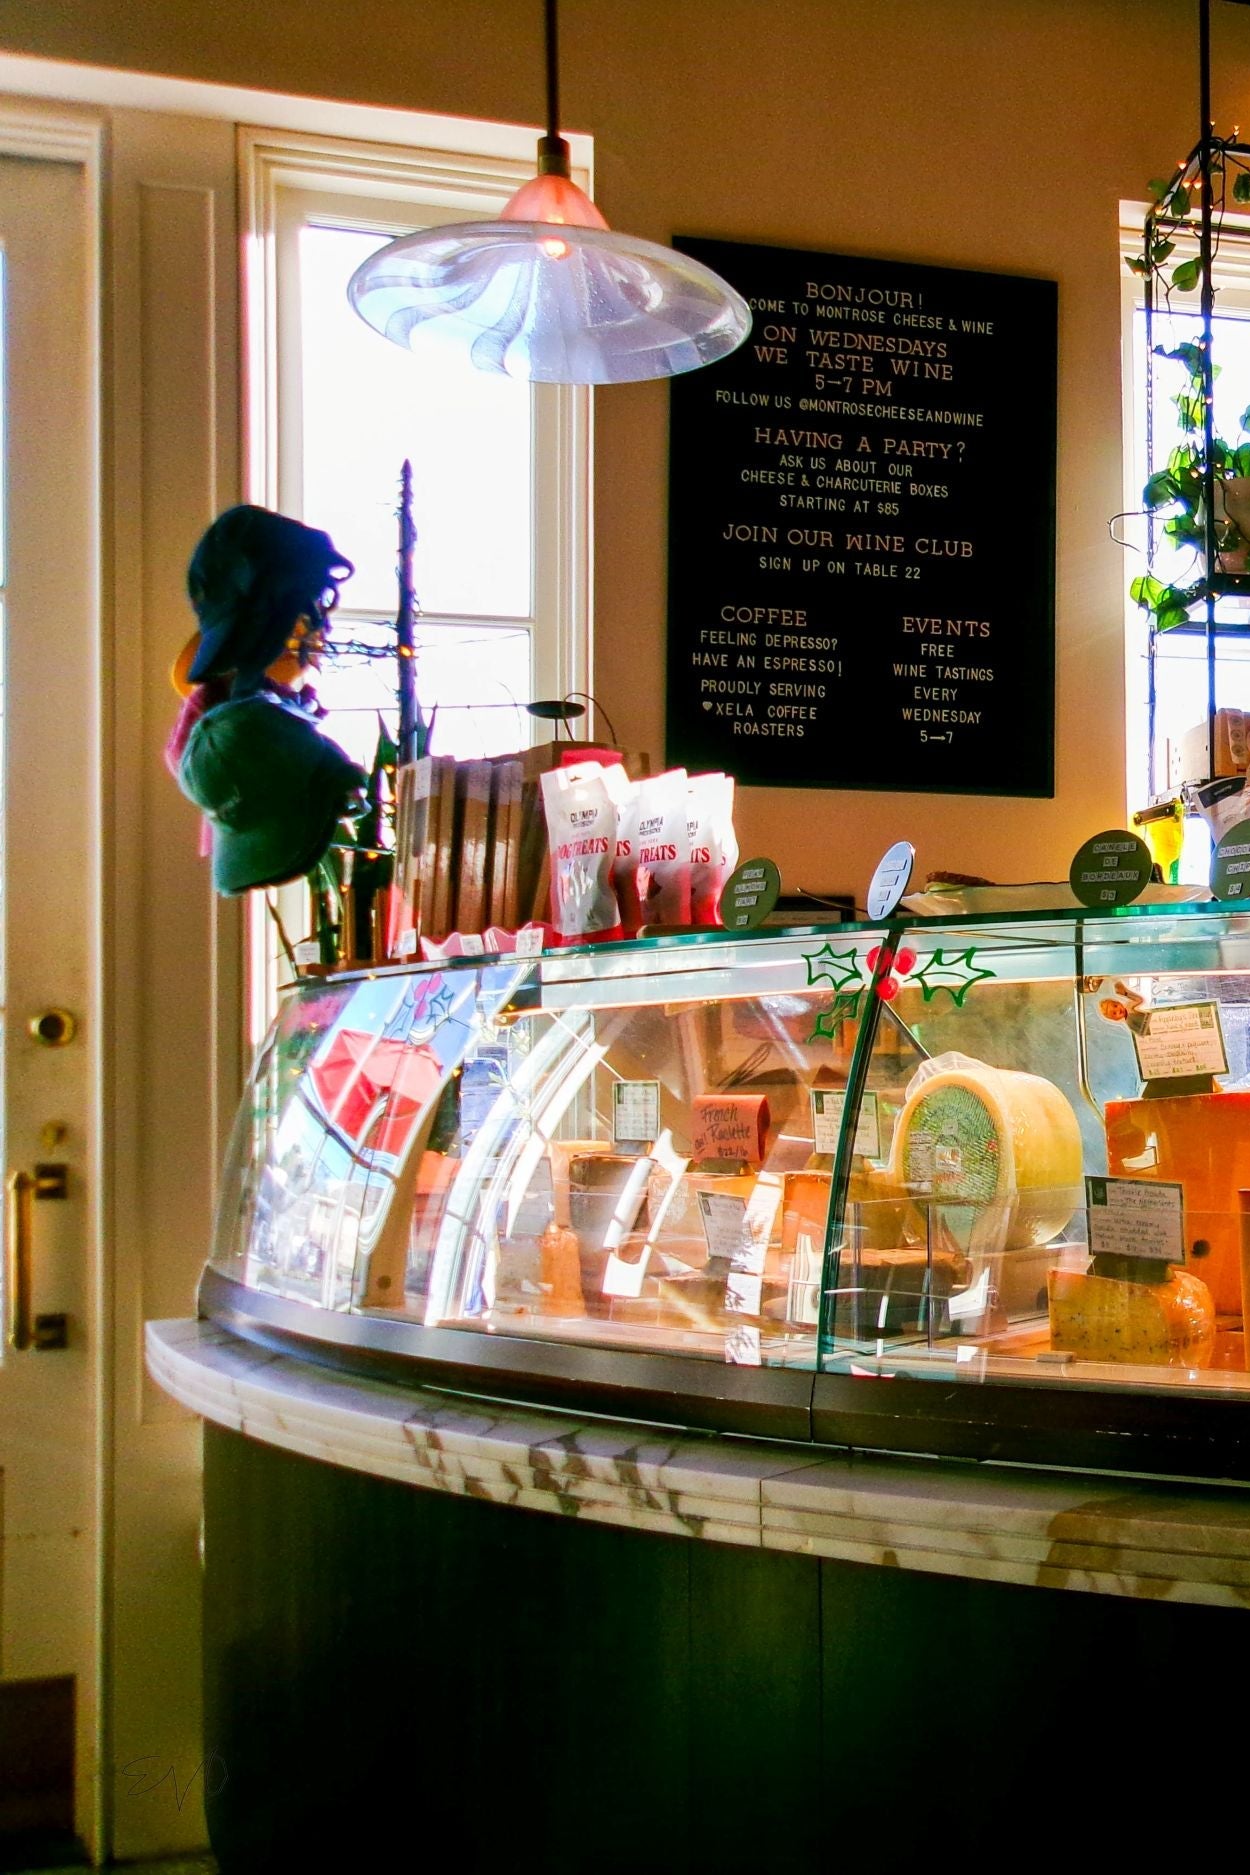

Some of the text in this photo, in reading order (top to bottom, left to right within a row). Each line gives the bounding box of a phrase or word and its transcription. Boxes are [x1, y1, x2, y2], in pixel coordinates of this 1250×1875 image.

[802, 282, 922, 313] BONJOUR!
[750, 298, 994, 335] COME TO MONTROSE CHEESE & WINE
[763, 325, 947, 358] ON WEDNESDAYS
[753, 345, 953, 381] WE TASTE WINE
[862, 378, 892, 397] PM
[716, 390, 984, 427] FOLLOW US @MONTROSECHEESEANDWINE
[755, 427, 966, 463] HAVING A PARTY?
[779, 454, 913, 477] ASK US ABOUT OUR
[741, 469, 949, 498] CHEESE & CHARCUTERIE BOXES
[779, 494, 900, 516] STARTING AT $85
[723, 523, 777, 543] JOIN
[787, 529, 834, 547] OUR
[915, 538, 973, 558] CLUB
[759, 556, 921, 579] SIGN UP ON TABLE 22
[720, 605, 807, 627] COFFEE
[902, 616, 990, 638] EVENTS
[700, 630, 838, 651] FEELING DEPRESSO?
[920, 643, 955, 658] FREE
[692, 652, 842, 676] HAVE AN ESPRESSO!
[892, 663, 994, 682] WINE TASTINGS
[700, 679, 826, 698] PROUDLY SERVING
[914, 686, 958, 701] EVERY
[716, 702, 817, 720] XELA COFFEE
[902, 708, 982, 724] WEDNESDAY
[733, 721, 805, 737] ROASTERS
[573, 837, 609, 858] TREATS
[639, 844, 677, 864] TREATS
